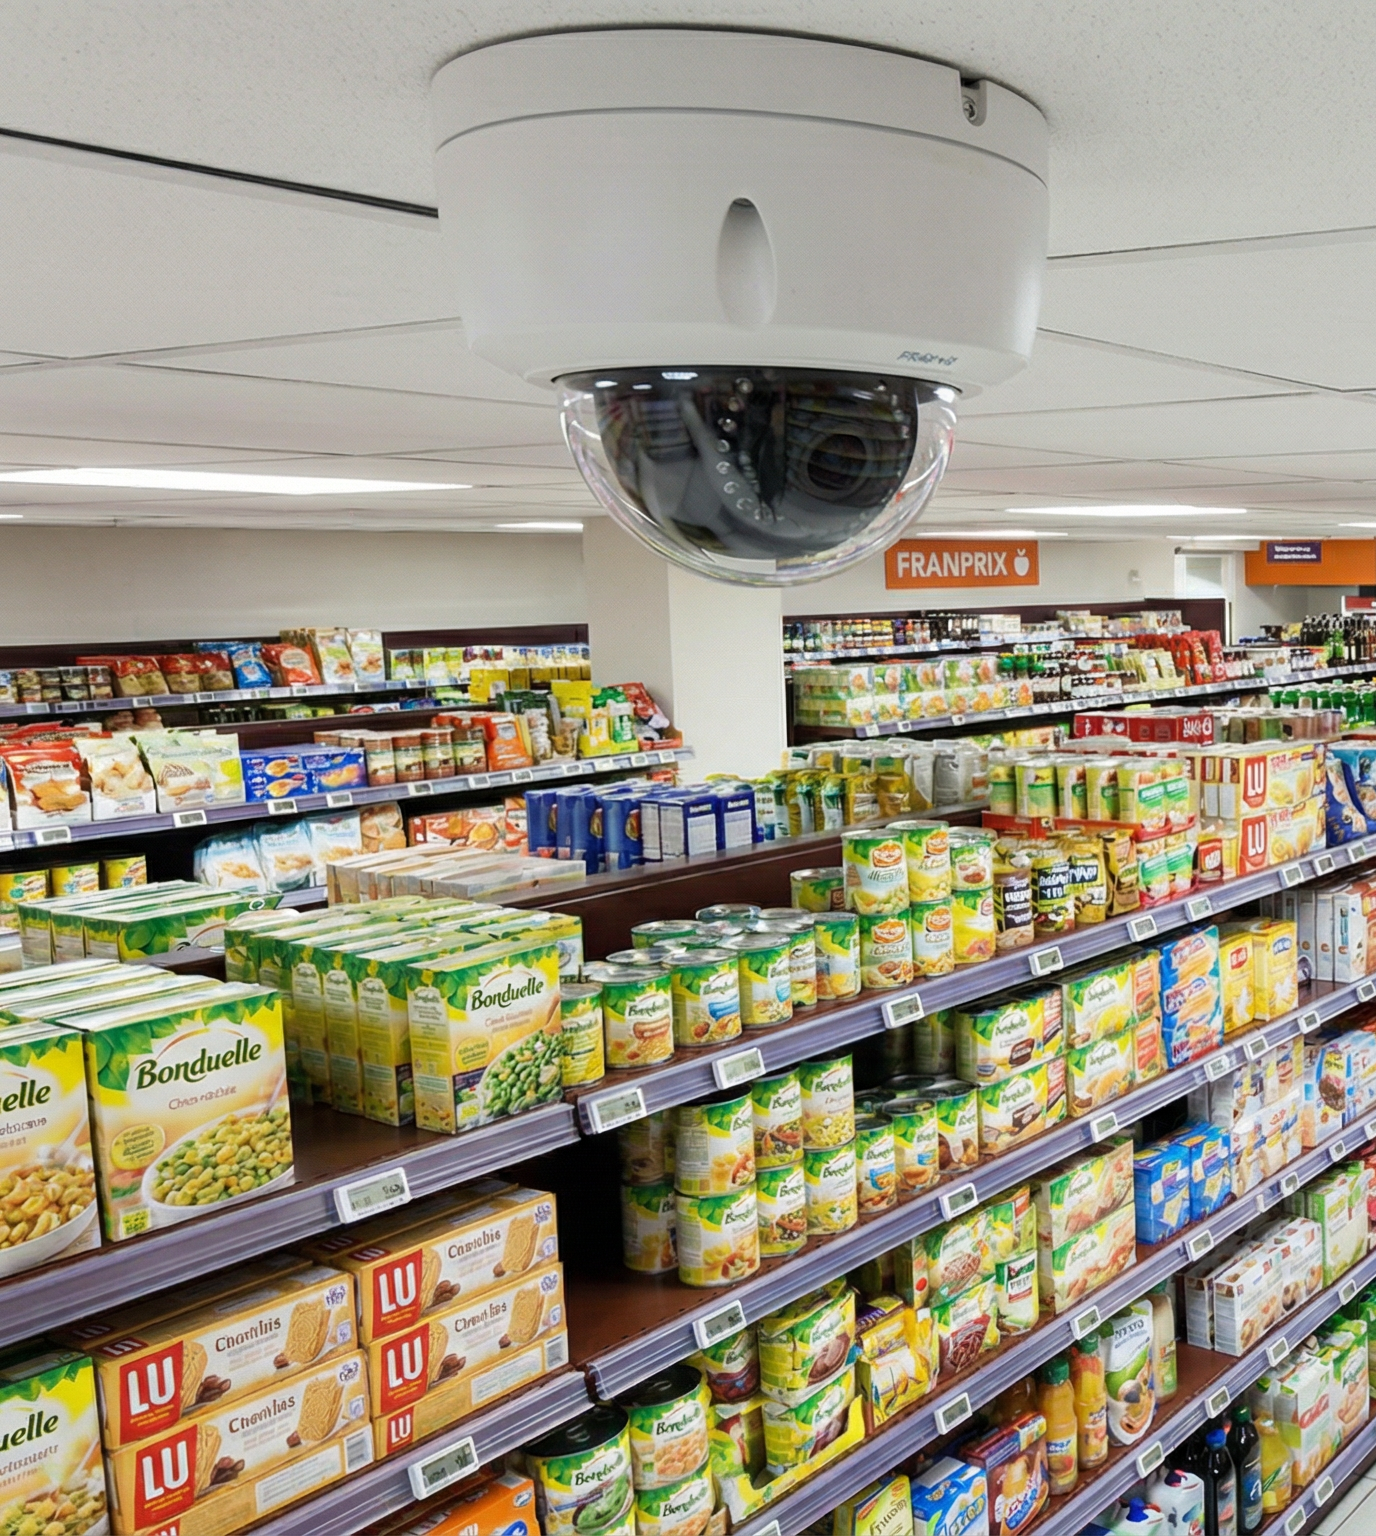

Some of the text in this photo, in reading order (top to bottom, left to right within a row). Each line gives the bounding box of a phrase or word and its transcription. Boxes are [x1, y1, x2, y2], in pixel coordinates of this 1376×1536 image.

[897, 551, 1008, 578] FRANPRIX
[1248, 762, 1264, 797] LU
[1248, 822, 1265, 856] LU
[471, 977, 544, 1012] Bonduelle
[134, 1037, 262, 1090] Bonduelle
[378, 1261, 417, 1315] LU
[387, 1336, 424, 1389] LU
[128, 1356, 175, 1416] LU
[390, 1413, 411, 1444] LU
[142, 1440, 189, 1501] LU
